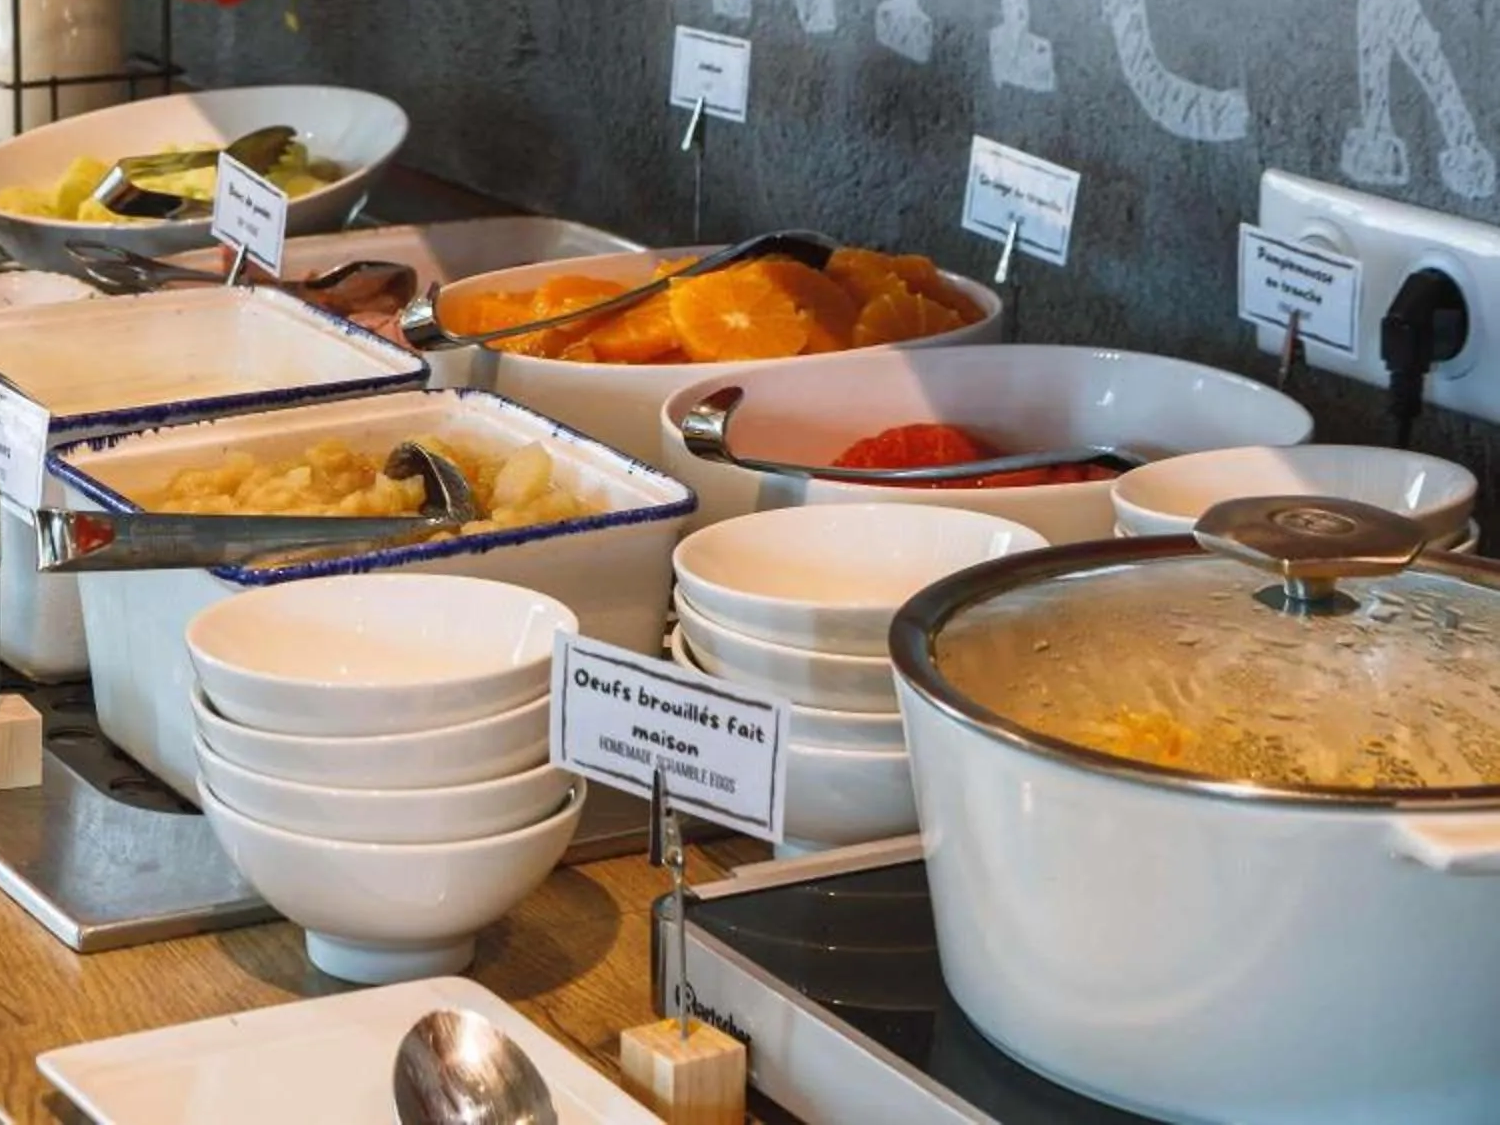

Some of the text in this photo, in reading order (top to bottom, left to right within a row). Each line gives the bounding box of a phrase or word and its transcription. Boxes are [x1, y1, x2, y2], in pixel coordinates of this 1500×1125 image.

[574, 667, 766, 745] Oeufs brouillés fait
[631, 724, 699, 757] maison
[709, 770, 737, 795] EGGS
